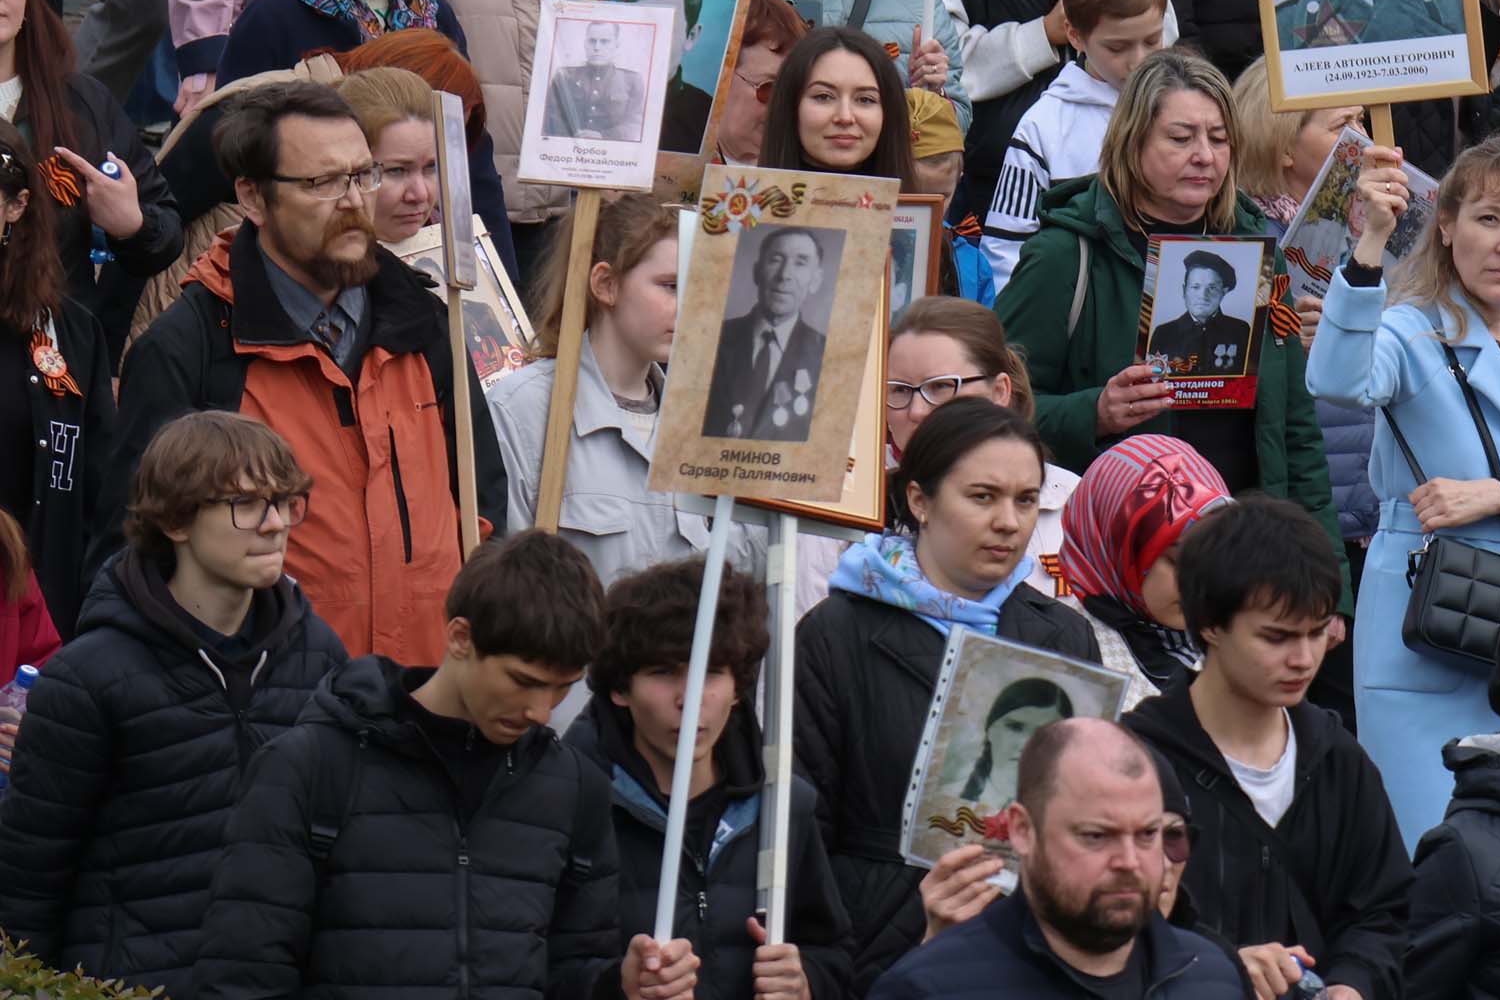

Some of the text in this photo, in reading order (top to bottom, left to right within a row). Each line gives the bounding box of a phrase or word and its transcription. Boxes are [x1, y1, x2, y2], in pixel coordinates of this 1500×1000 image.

[1293, 48, 1456, 75] АЛЕЕВ АВТОНОМ ЕГОРОВИЧ
[1324, 65, 1429, 85] (24.09.1923-7.03.2006)
[572, 144, 608, 156] Горбов
[539, 153, 638, 168] Федор Михайлович
[1174, 390, 1209, 400] Ямаш
[50, 420, 80, 491] H
[720, 450, 782, 465] ЯМИНОВ
[678, 462, 816, 483] Сарвар Галлямович
